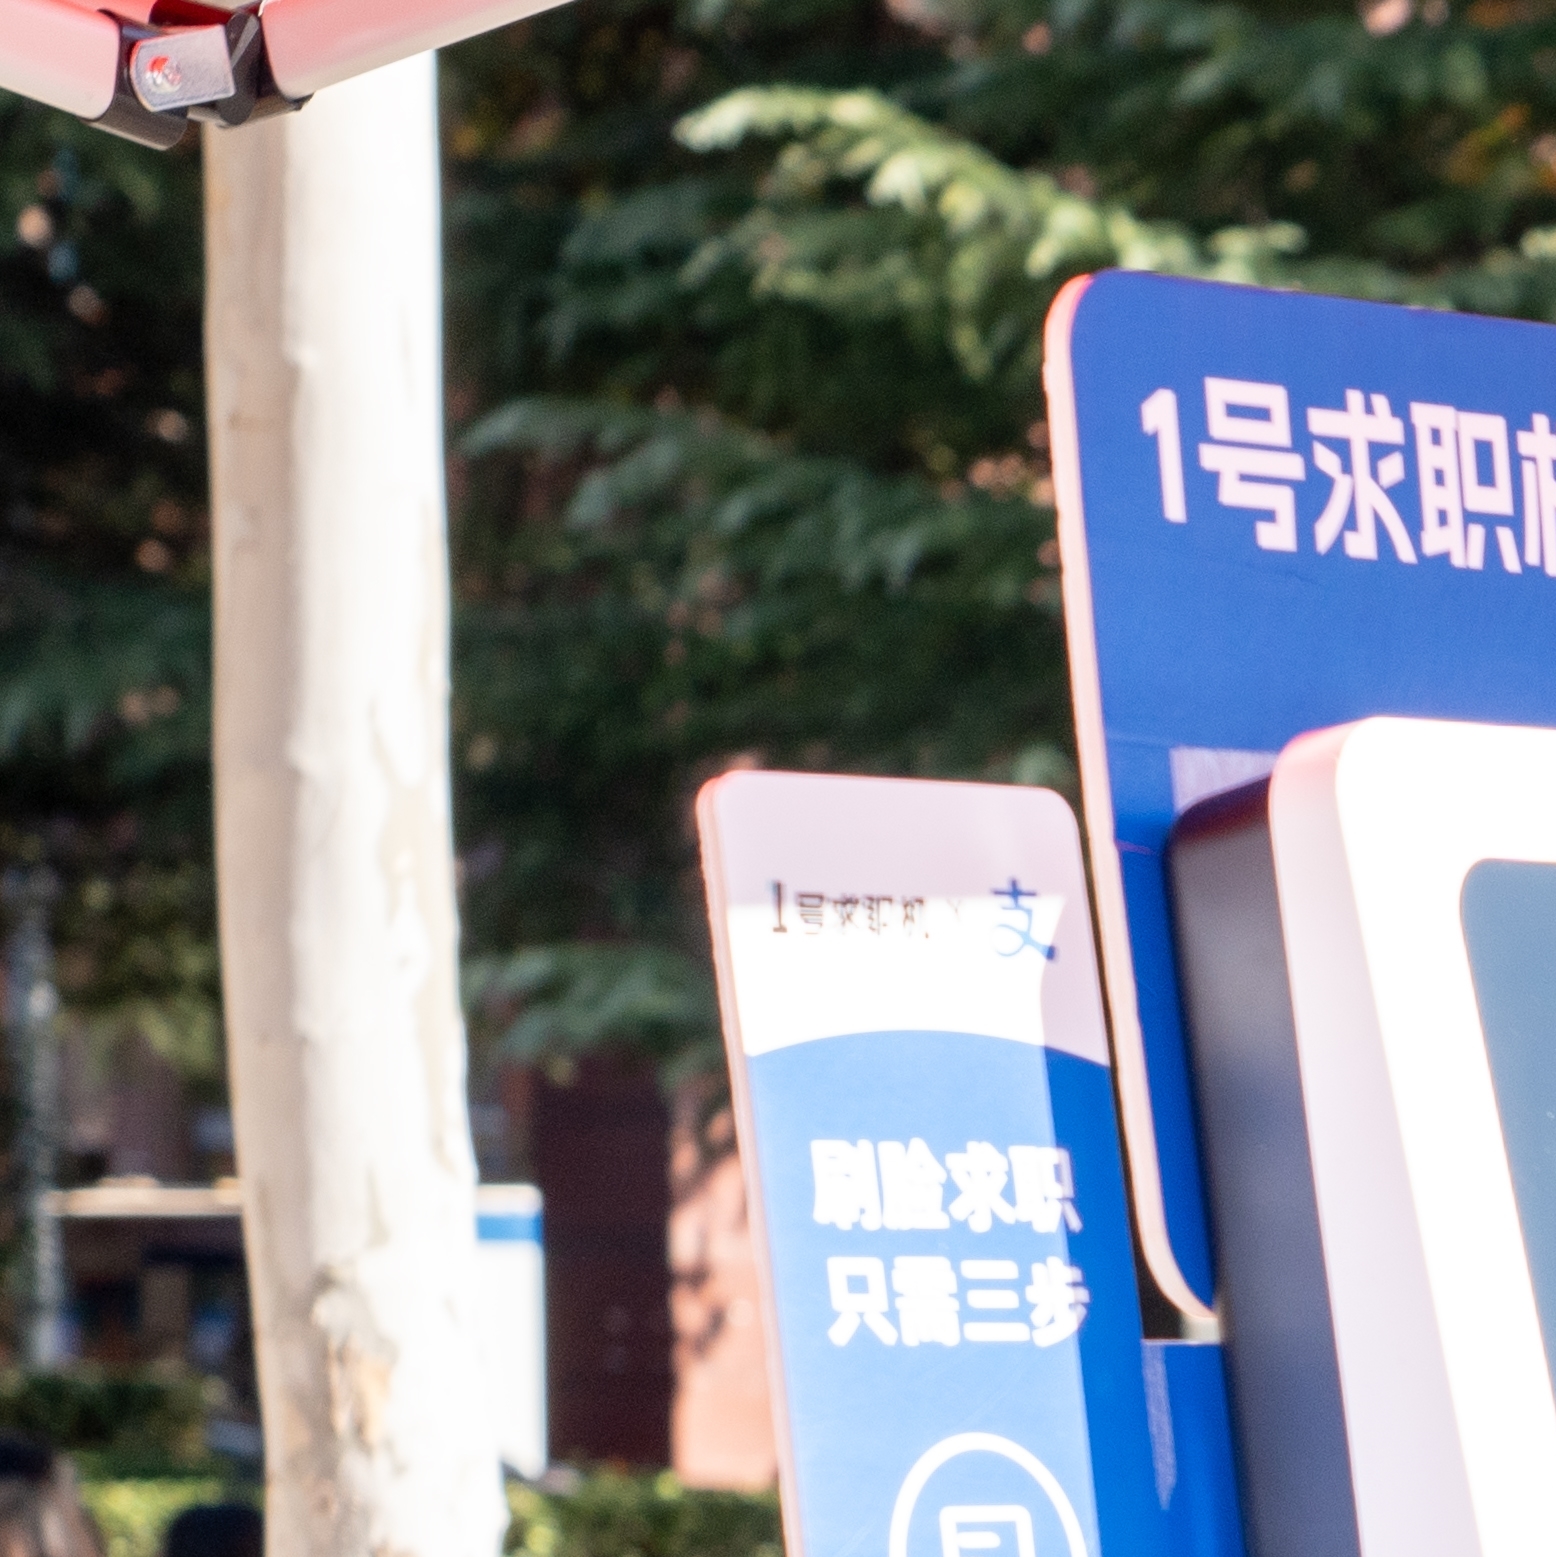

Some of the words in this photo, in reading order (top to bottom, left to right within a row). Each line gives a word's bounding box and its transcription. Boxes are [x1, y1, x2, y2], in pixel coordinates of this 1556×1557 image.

[809, 1136, 1083, 1234] 刷脸求职
[826, 1255, 1091, 1348] 只需三步
